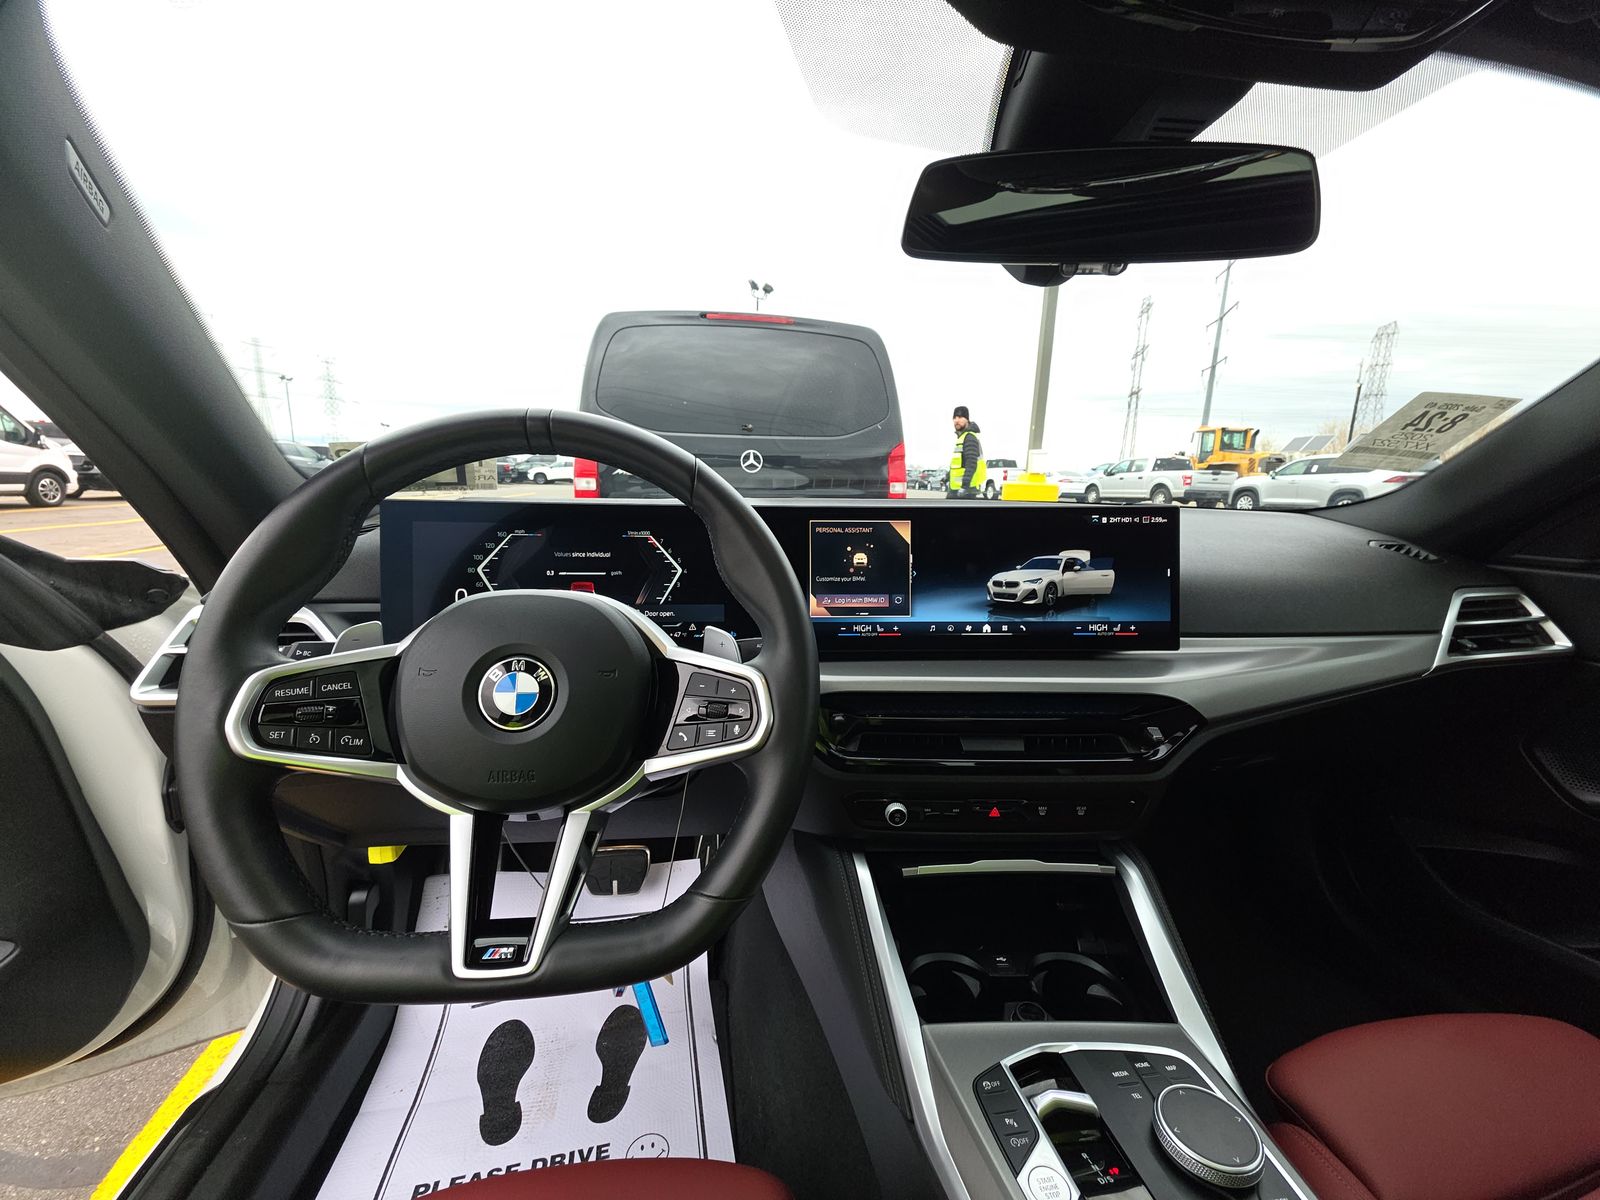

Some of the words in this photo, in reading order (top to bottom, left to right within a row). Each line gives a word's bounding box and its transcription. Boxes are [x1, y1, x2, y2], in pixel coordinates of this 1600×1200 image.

[74, 161, 105, 214] AIRBAG
[488, 660, 549, 682] BMW
[275, 686, 309, 697] RESUME
[321, 682, 353, 692] CANCEL
[269, 731, 285, 739] SET
[488, 769, 537, 784] AIRBAG
[1112, 1070, 1130, 1078] MEDIA
[531, 1143, 611, 1170] DRIVE
[1037, 1176, 1055, 1185] START
[1045, 1191, 1061, 1200] STOP
